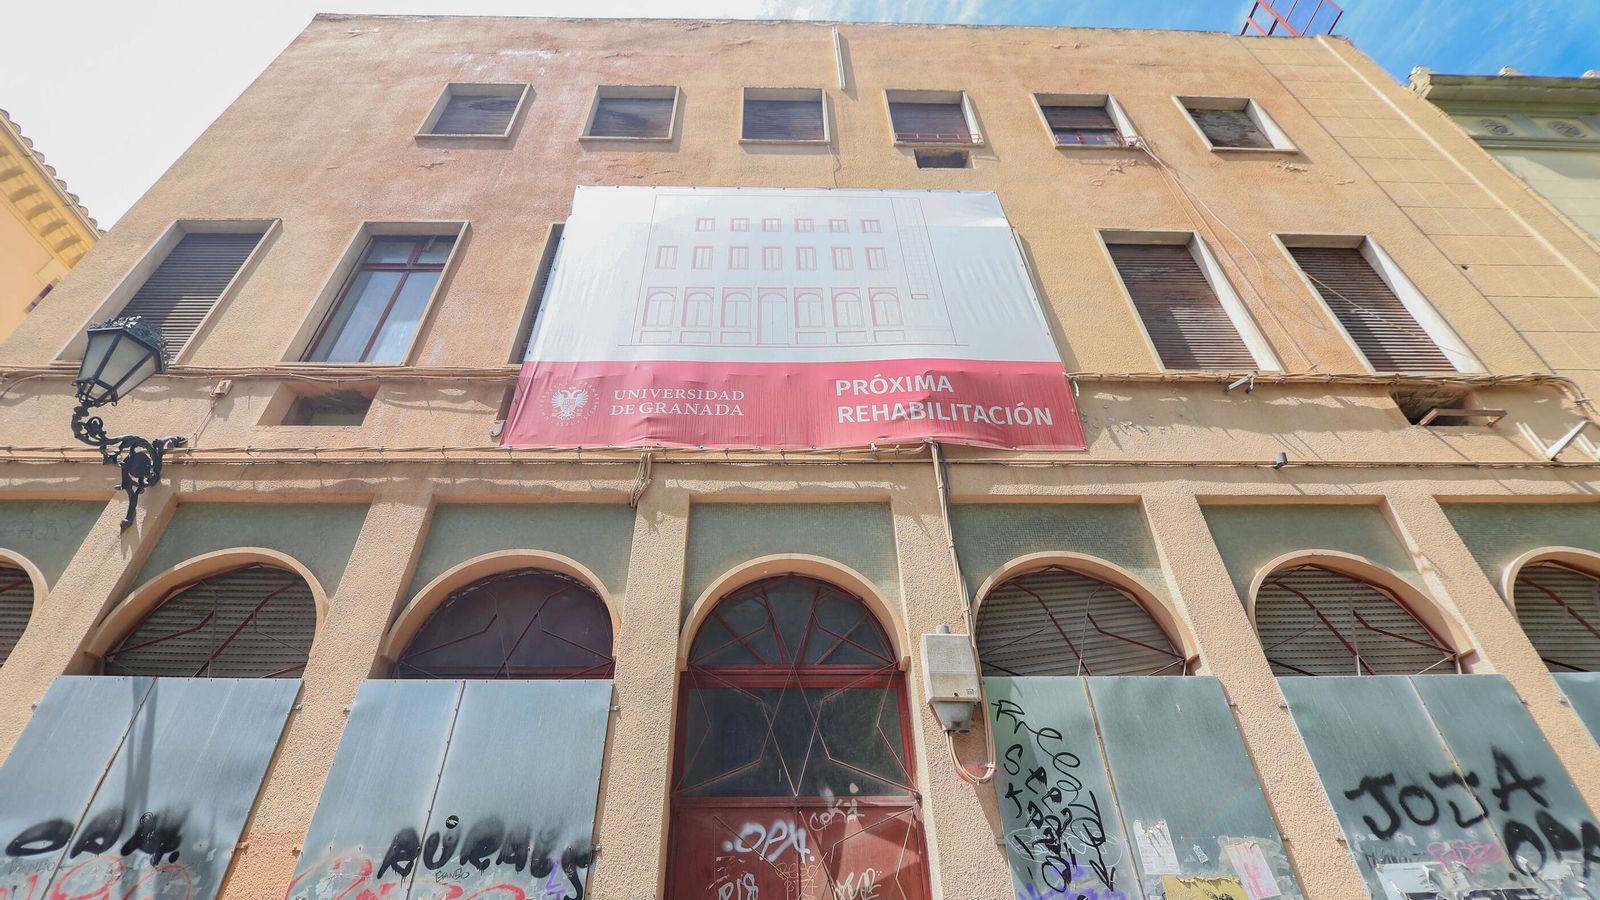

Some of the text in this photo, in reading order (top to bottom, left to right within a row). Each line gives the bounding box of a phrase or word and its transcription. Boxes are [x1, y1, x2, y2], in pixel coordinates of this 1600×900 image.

[835, 373, 954, 396] PRÓXIMA
[614, 388, 745, 401] UNIVERSIDAD
[610, 402, 744, 416] DE GRANADA
[837, 401, 1053, 426] REHABILITACIÓN
